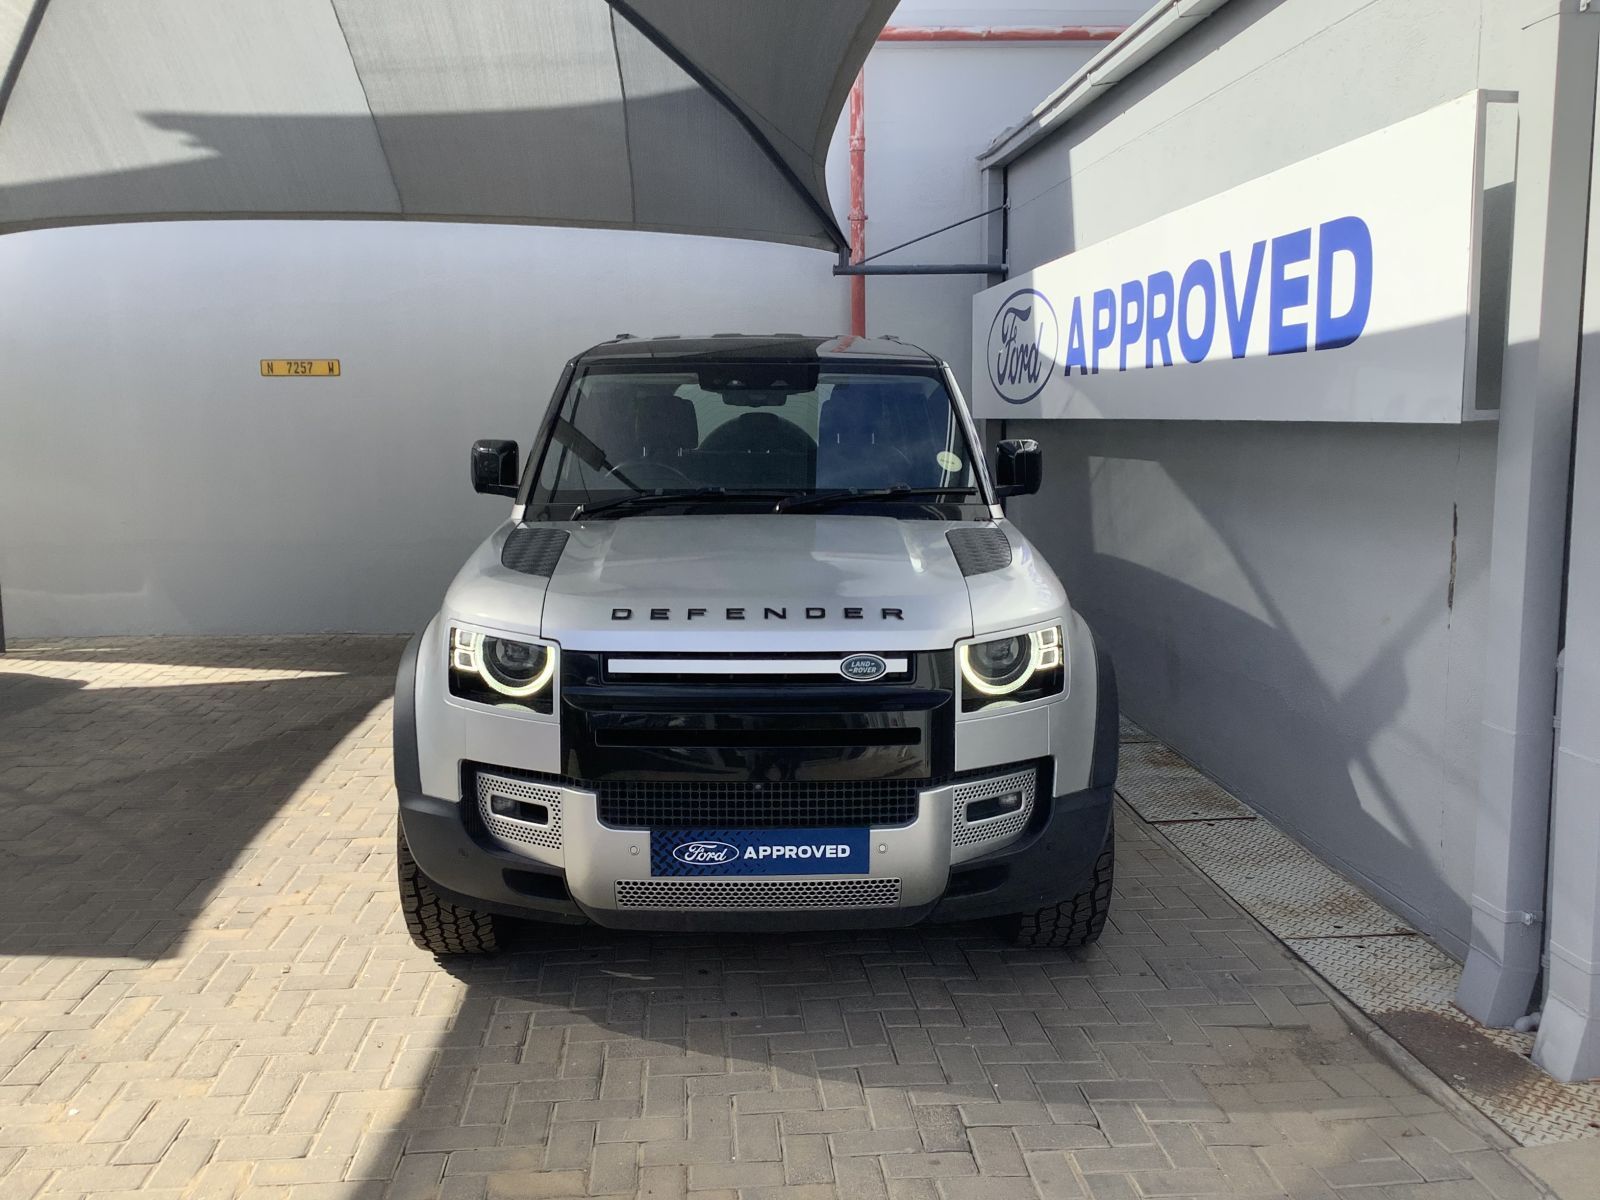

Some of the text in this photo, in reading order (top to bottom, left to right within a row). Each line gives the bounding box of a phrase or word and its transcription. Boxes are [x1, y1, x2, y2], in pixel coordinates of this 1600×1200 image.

[996, 215, 1374, 386] Ford APPROVED
[266, 362, 274, 375] N
[286, 361, 313, 375] 7257
[611, 606, 905, 621] DEFENDER
[683, 842, 851, 863] Ford APPROVED
